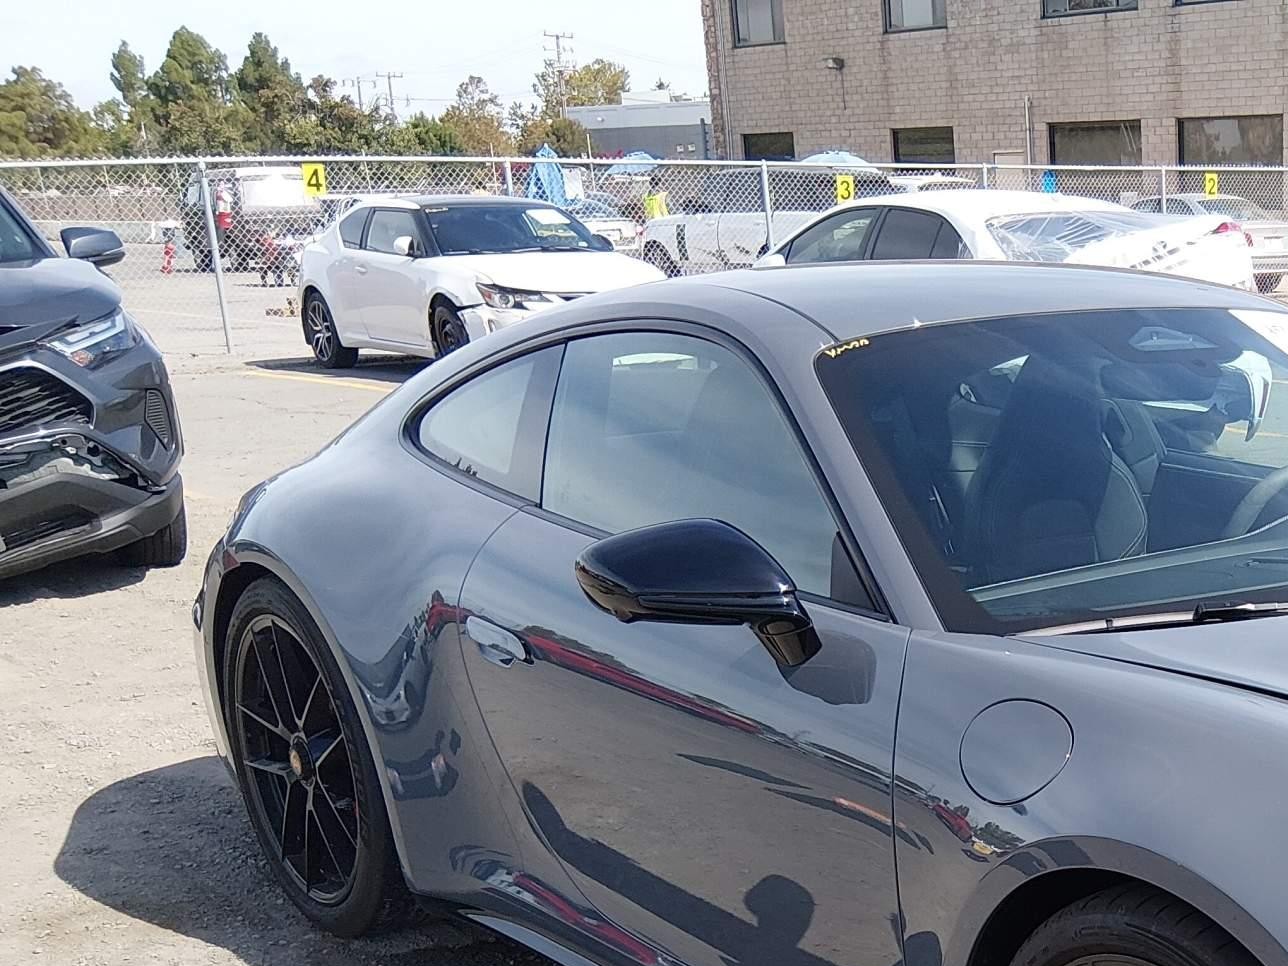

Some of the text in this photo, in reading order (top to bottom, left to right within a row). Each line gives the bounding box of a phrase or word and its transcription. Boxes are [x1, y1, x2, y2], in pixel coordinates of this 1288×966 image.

[307, 168, 323, 192] 4
[840, 180, 851, 199] 3
[1208, 177, 1216, 195] 2
